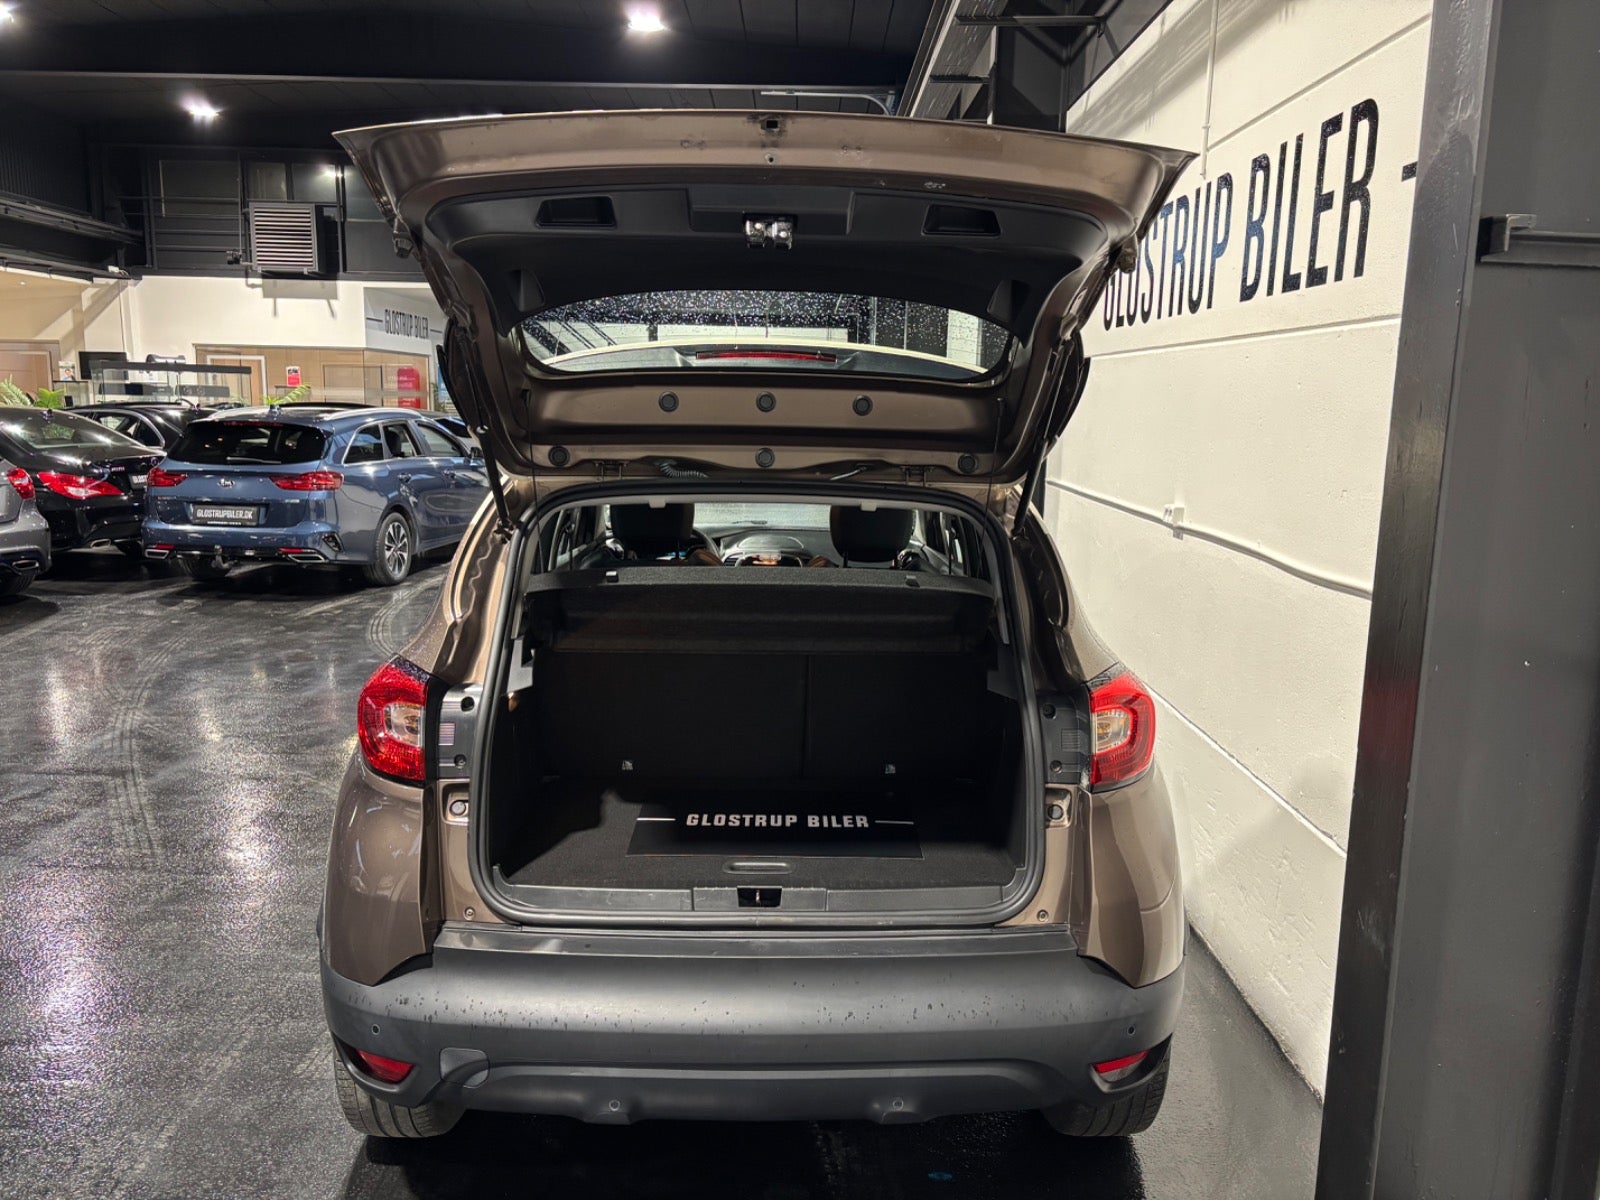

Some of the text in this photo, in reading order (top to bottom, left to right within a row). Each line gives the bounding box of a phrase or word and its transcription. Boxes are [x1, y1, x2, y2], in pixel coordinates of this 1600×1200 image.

[1103, 98, 1379, 331] GLOSTRUP BILER
[385, 309, 429, 339] GLOSTRUP BILER
[686, 813, 869, 828] GLOSTRUP BILER
